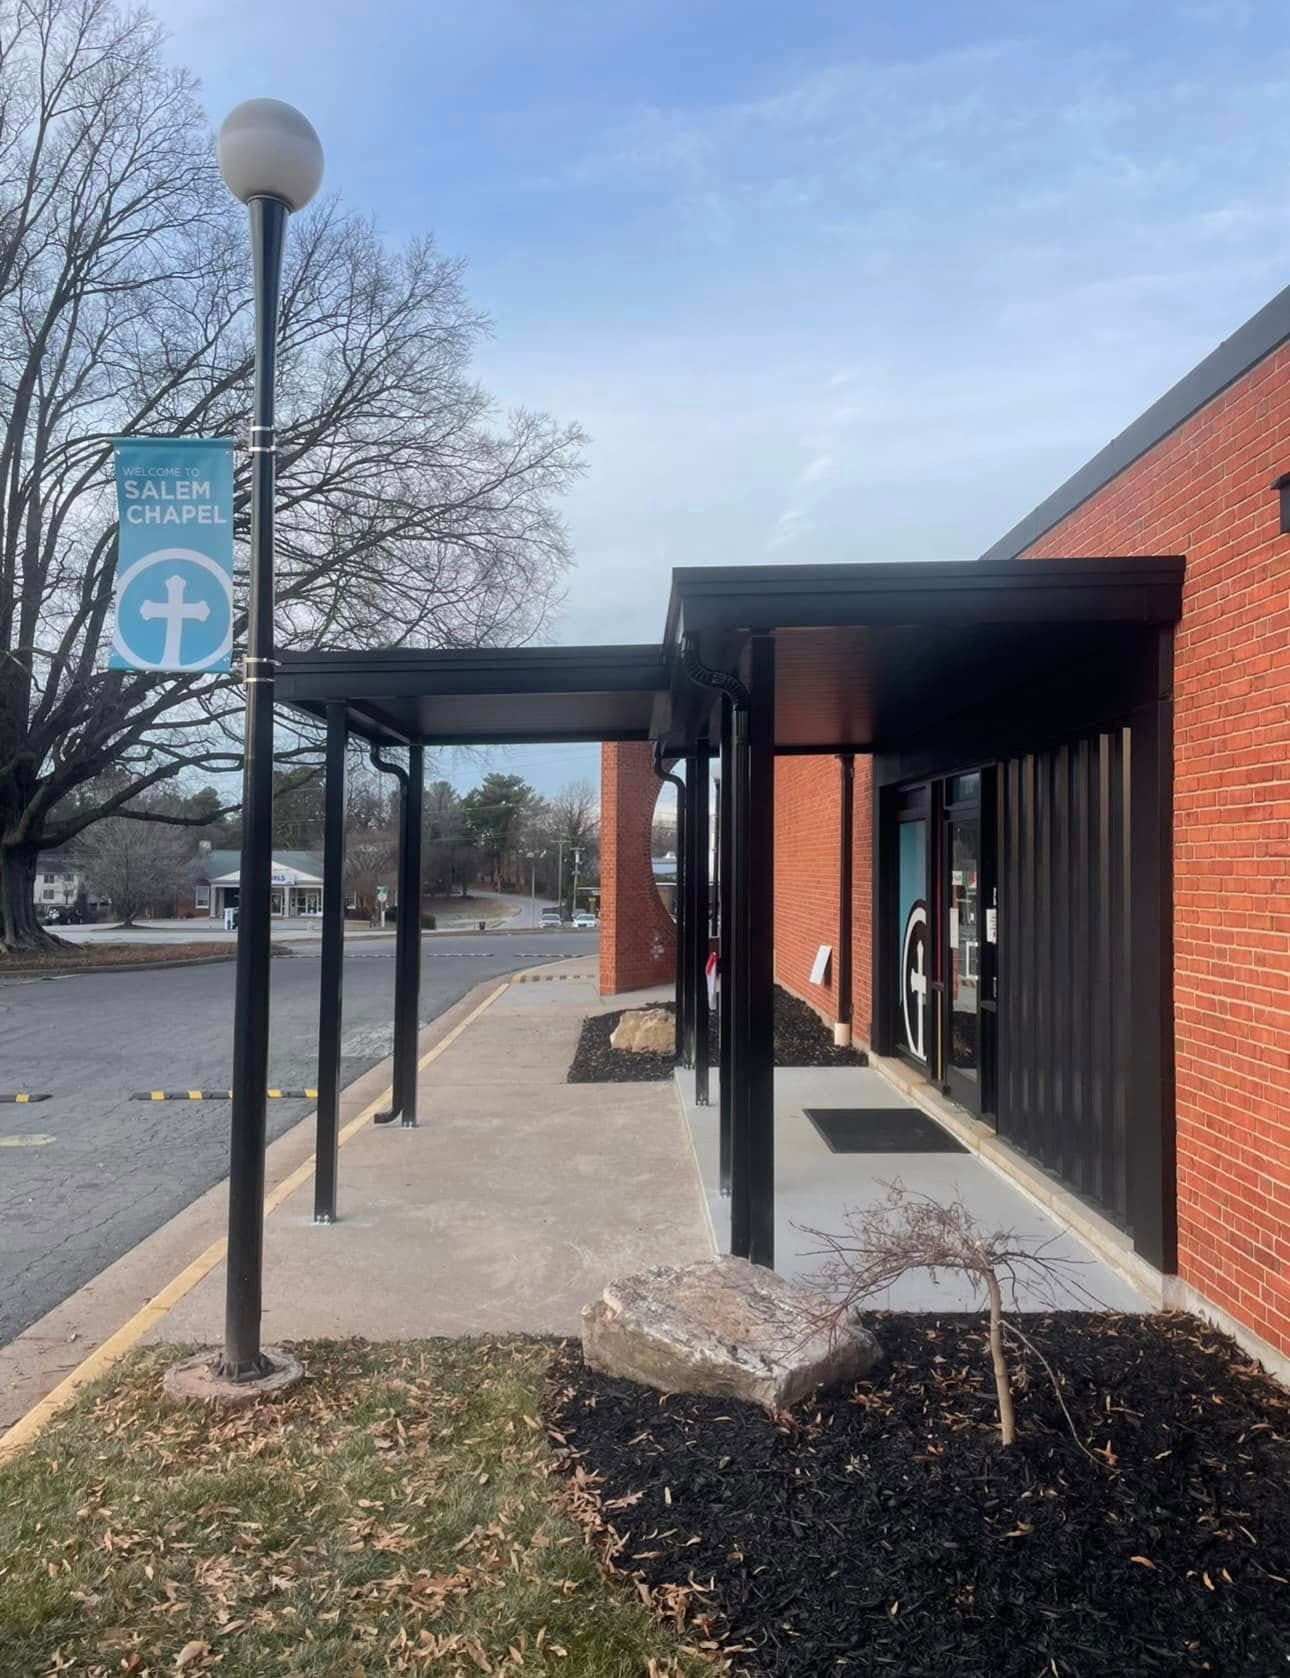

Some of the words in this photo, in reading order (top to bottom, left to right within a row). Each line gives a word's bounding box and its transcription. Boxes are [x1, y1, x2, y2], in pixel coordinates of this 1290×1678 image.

[122, 467, 181, 477] WELCOME
[185, 467, 200, 477] TO
[124, 480, 210, 499] SALEM
[126, 505, 227, 524] CHAPEL
